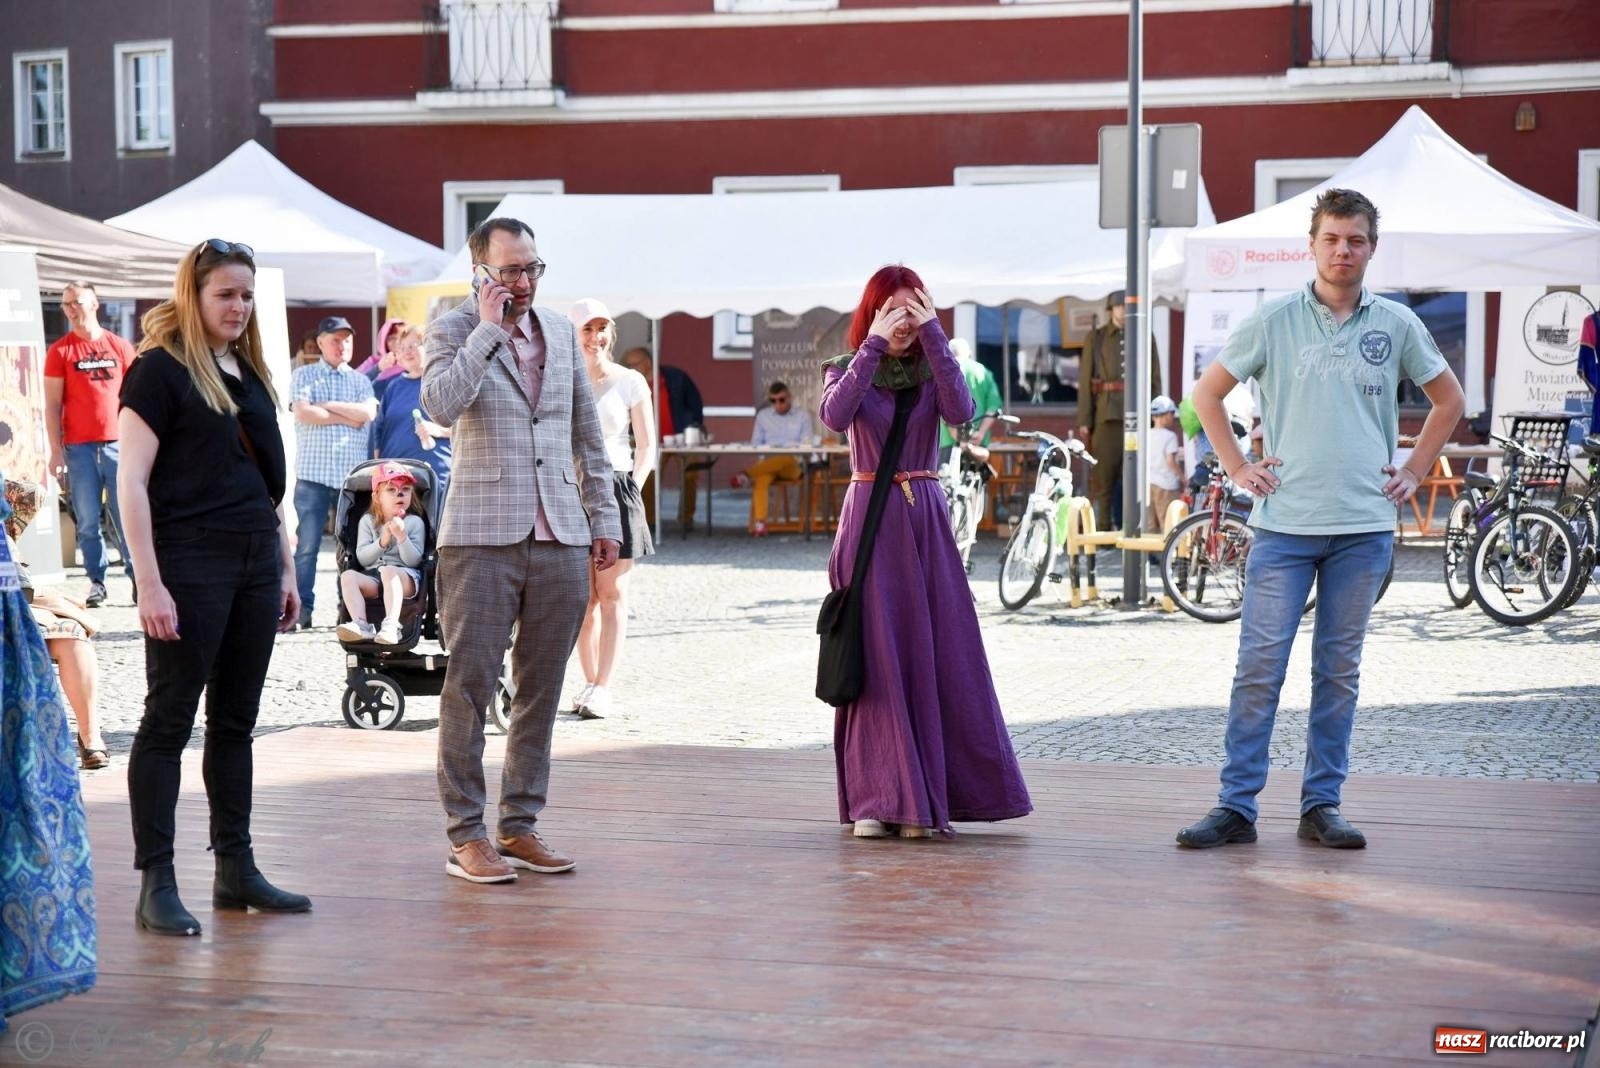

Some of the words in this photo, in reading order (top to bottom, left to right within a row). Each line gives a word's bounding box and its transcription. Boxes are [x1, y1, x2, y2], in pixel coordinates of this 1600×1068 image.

[761, 343, 817, 353] MUZEUM
[761, 359, 822, 370] POWIATO
[1524, 369, 1584, 384] Powiatow
[1528, 386, 1564, 401] Muze
